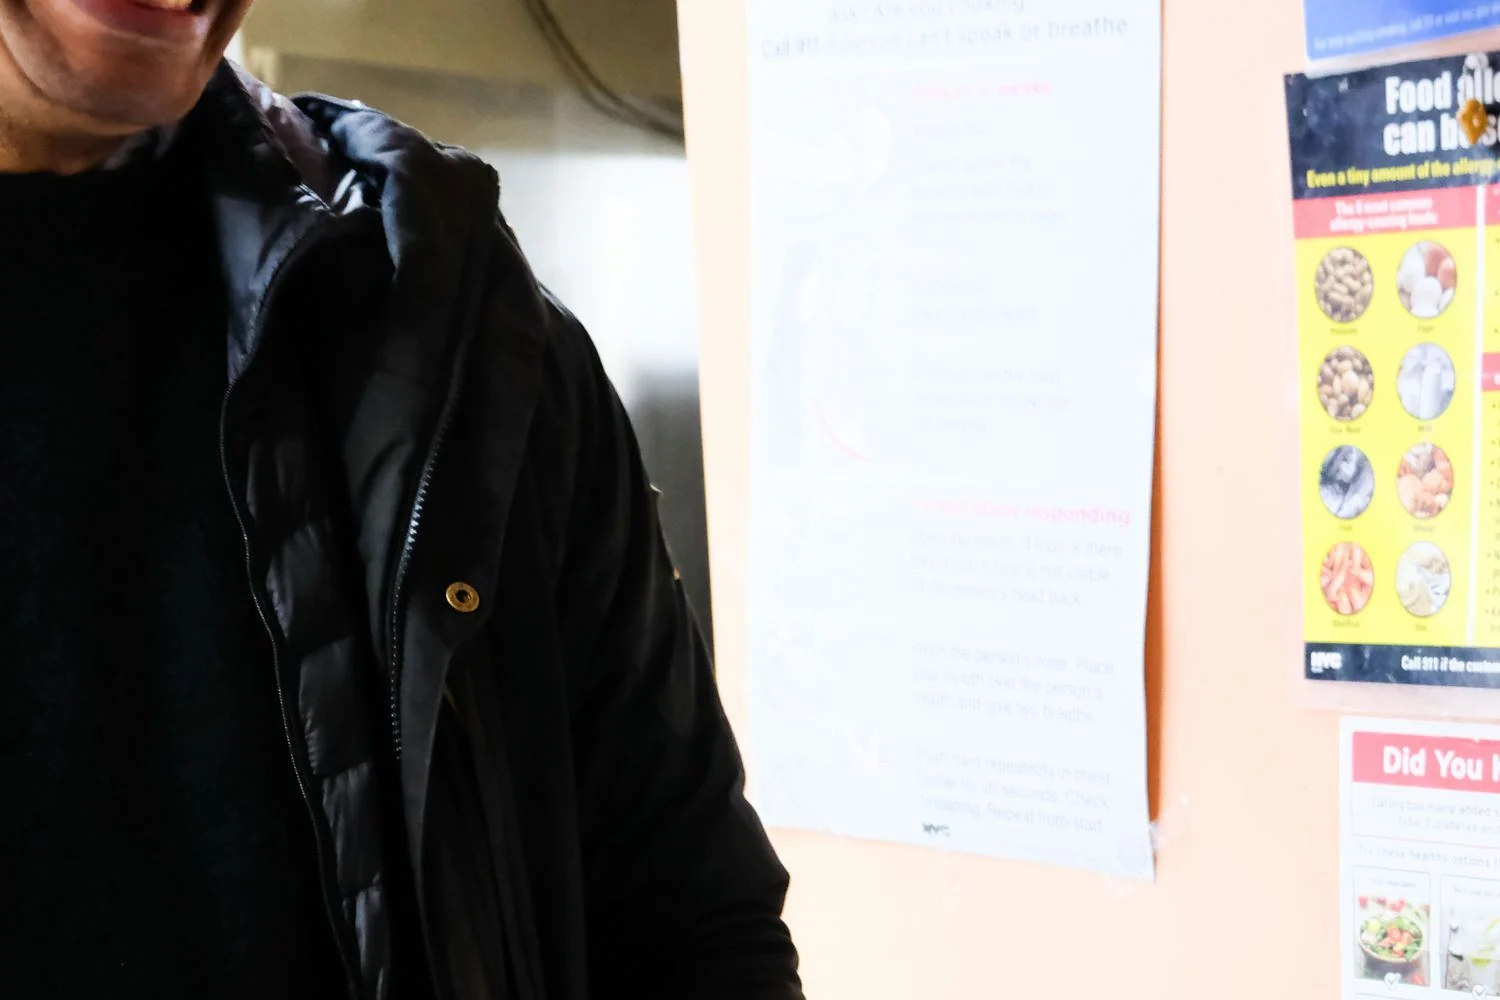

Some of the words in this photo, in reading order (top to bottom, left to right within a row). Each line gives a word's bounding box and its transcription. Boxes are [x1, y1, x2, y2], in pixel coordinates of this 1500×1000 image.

[1020, 23, 1040, 42] or
[1048, 16, 1127, 41] breathe
[1385, 71, 1452, 115] Food
[1382, 119, 1436, 156] can
[1307, 169, 1336, 188] Even
[1337, 171, 1346, 186] a
[1347, 167, 1369, 187] tiny
[1371, 164, 1415, 183] amount
[1417, 161, 1430, 179] of
[1431, 160, 1451, 178] the
[1024, 504, 1130, 528] responding
[1401, 655, 1421, 672] Call
[1422, 656, 1439, 672] 911
[1440, 656, 1449, 672] if
[1449, 657, 1465, 673] the
[1383, 746, 1426, 775] Did
[1433, 749, 1483, 781] You
[1371, 796, 1403, 812] Eating
[1407, 800, 1424, 811] too
[1459, 805, 1491, 818] added
[1433, 820, 1477, 833] diabetes
